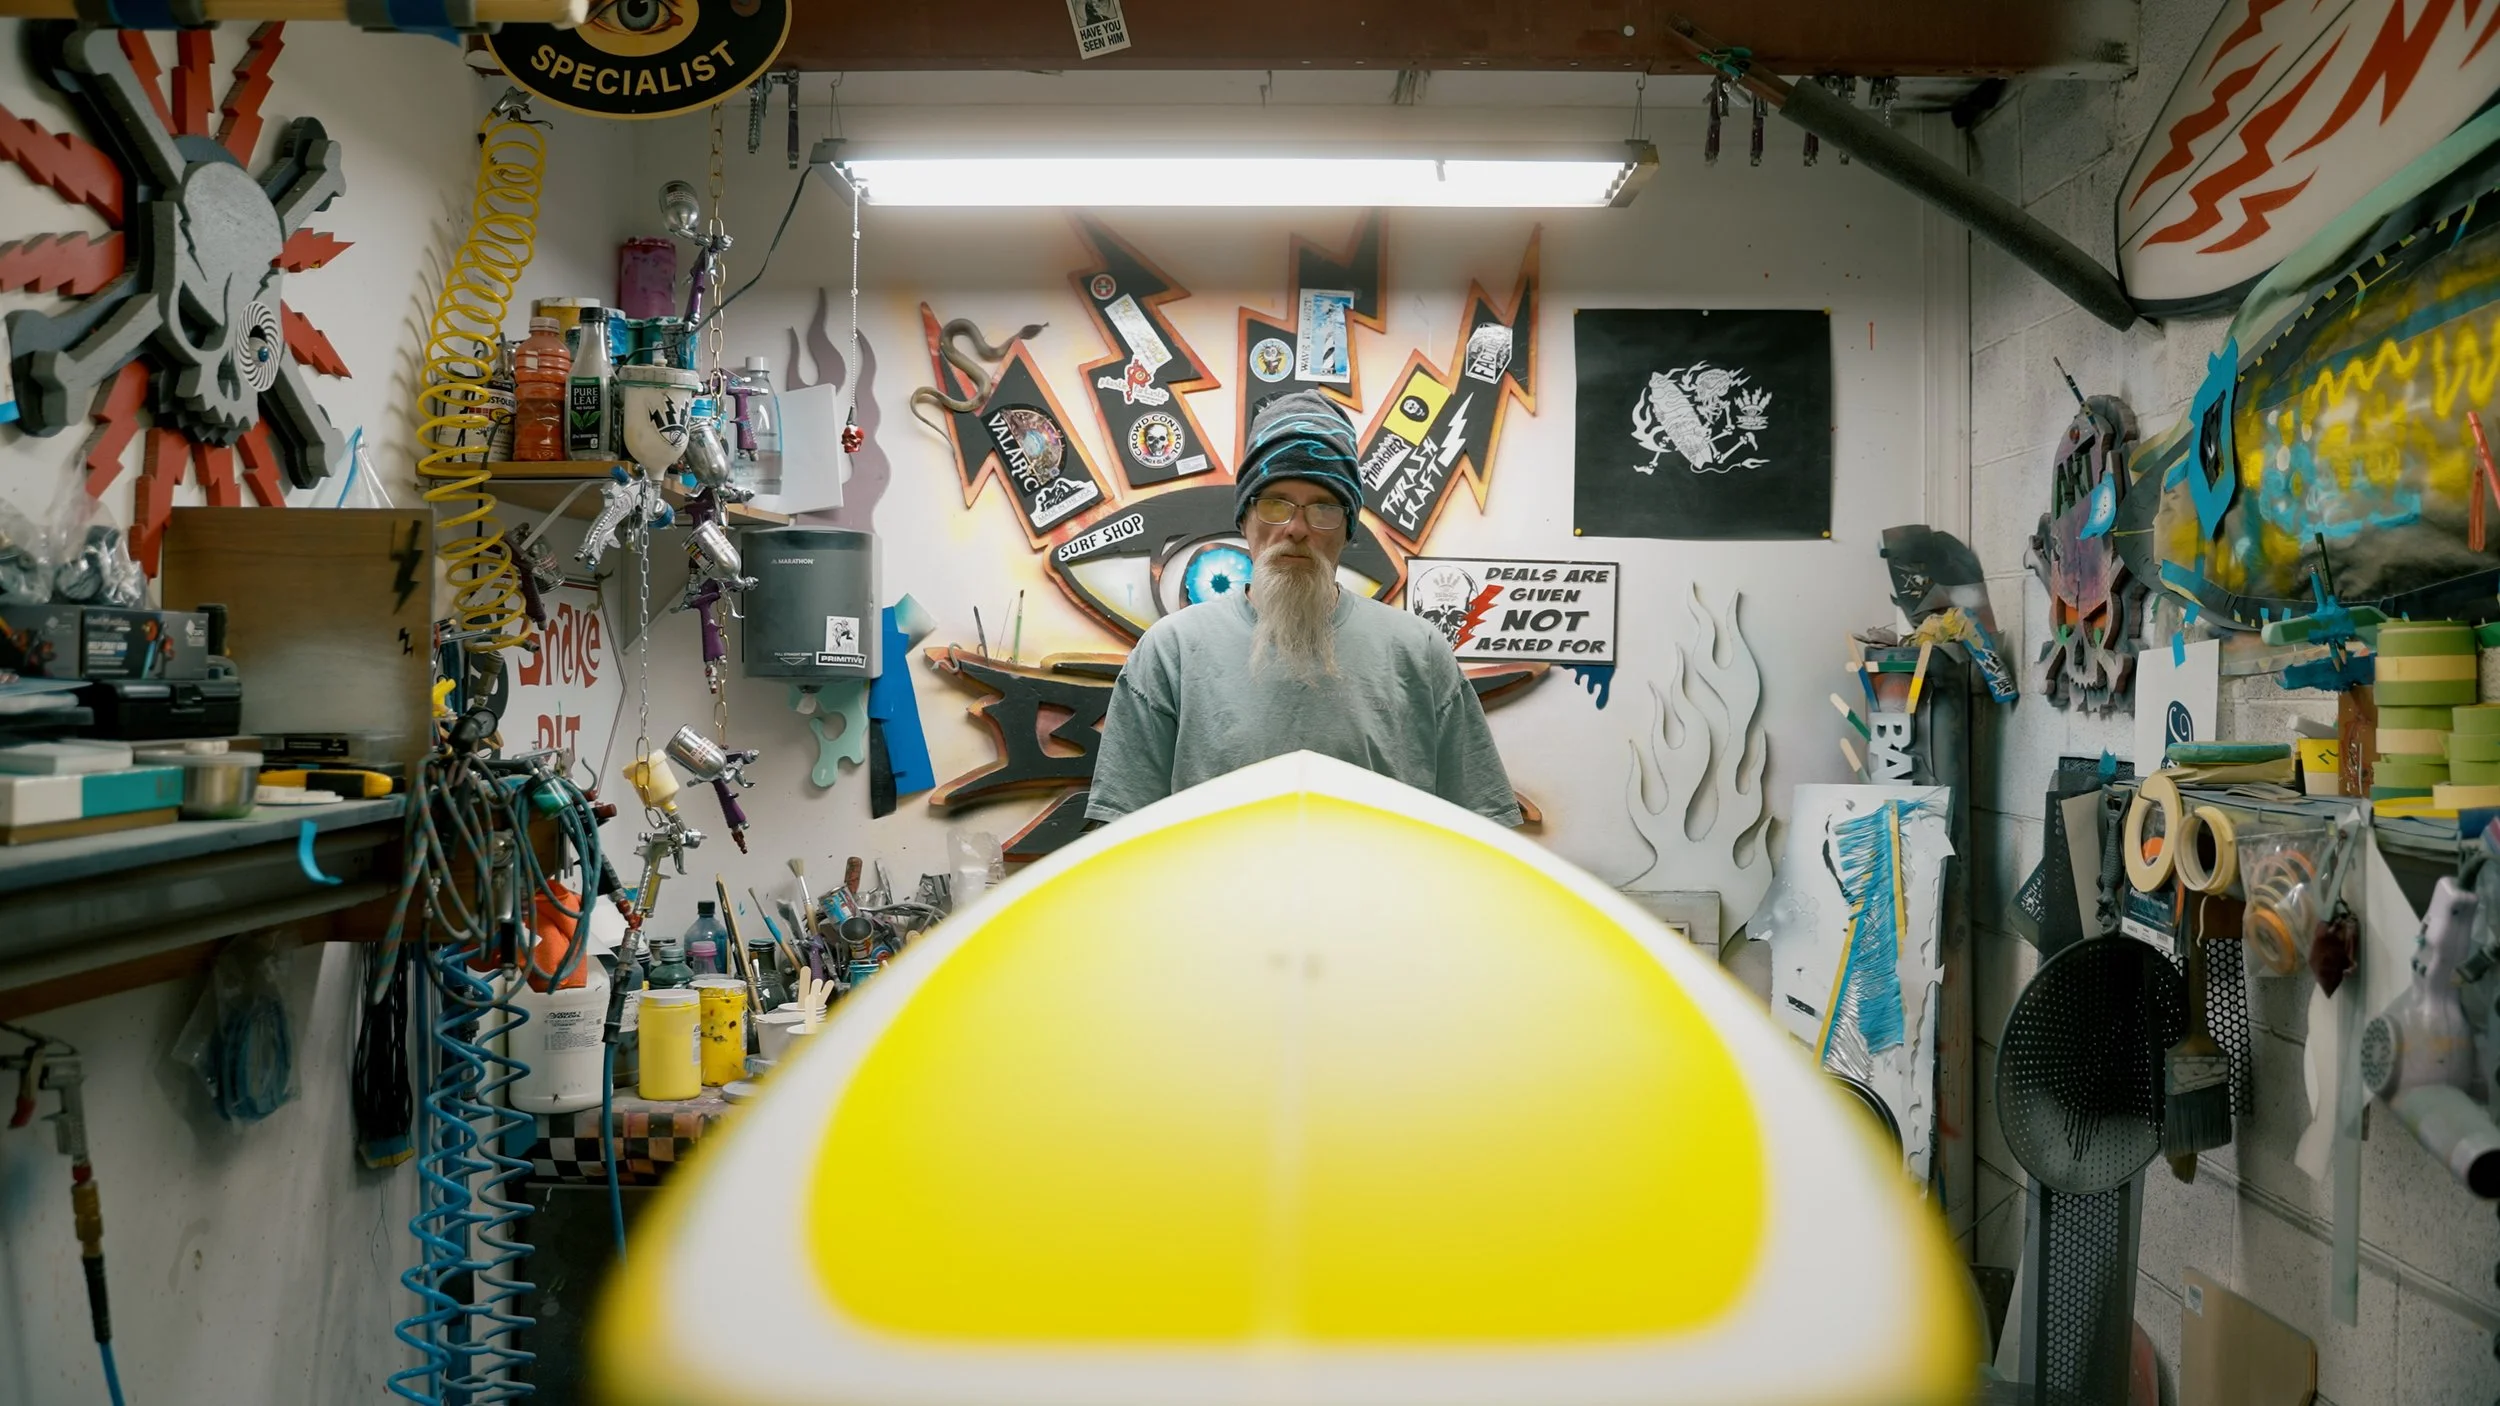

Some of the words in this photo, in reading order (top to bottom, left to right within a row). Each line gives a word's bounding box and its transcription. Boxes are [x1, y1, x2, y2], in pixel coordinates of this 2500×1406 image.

[1080, 25, 1103, 40] HAVE
[1102, 20, 1121, 34] YOU
[1083, 36, 1105, 52] SEEN
[1107, 32, 1125, 46] HIM
[530, 40, 736, 96] SPECIALIST
[574, 387, 599, 396] PURE
[574, 396, 598, 405] LEAF
[1131, 417, 1149, 456] CROWD
[1152, 415, 1182, 454] CONTROL
[988, 412, 1040, 492] VALARIC
[1363, 438, 1407, 487] THRASHER
[1381, 436, 1438, 516] THRASH
[1398, 455, 1443, 531] CRAFT
[1061, 534, 1097, 558] SURF
[1103, 515, 1141, 542] SHOP
[1485, 567, 1557, 582] DEALS
[1563, 569, 1610, 583] ARE
[1509, 587, 1581, 603] GIVEN
[1500, 609, 1590, 632] NOT
[1474, 637, 1553, 652] ASKED
[1558, 639, 1606, 654] FOR
[821, 655, 863, 664] PRIMITIVE
